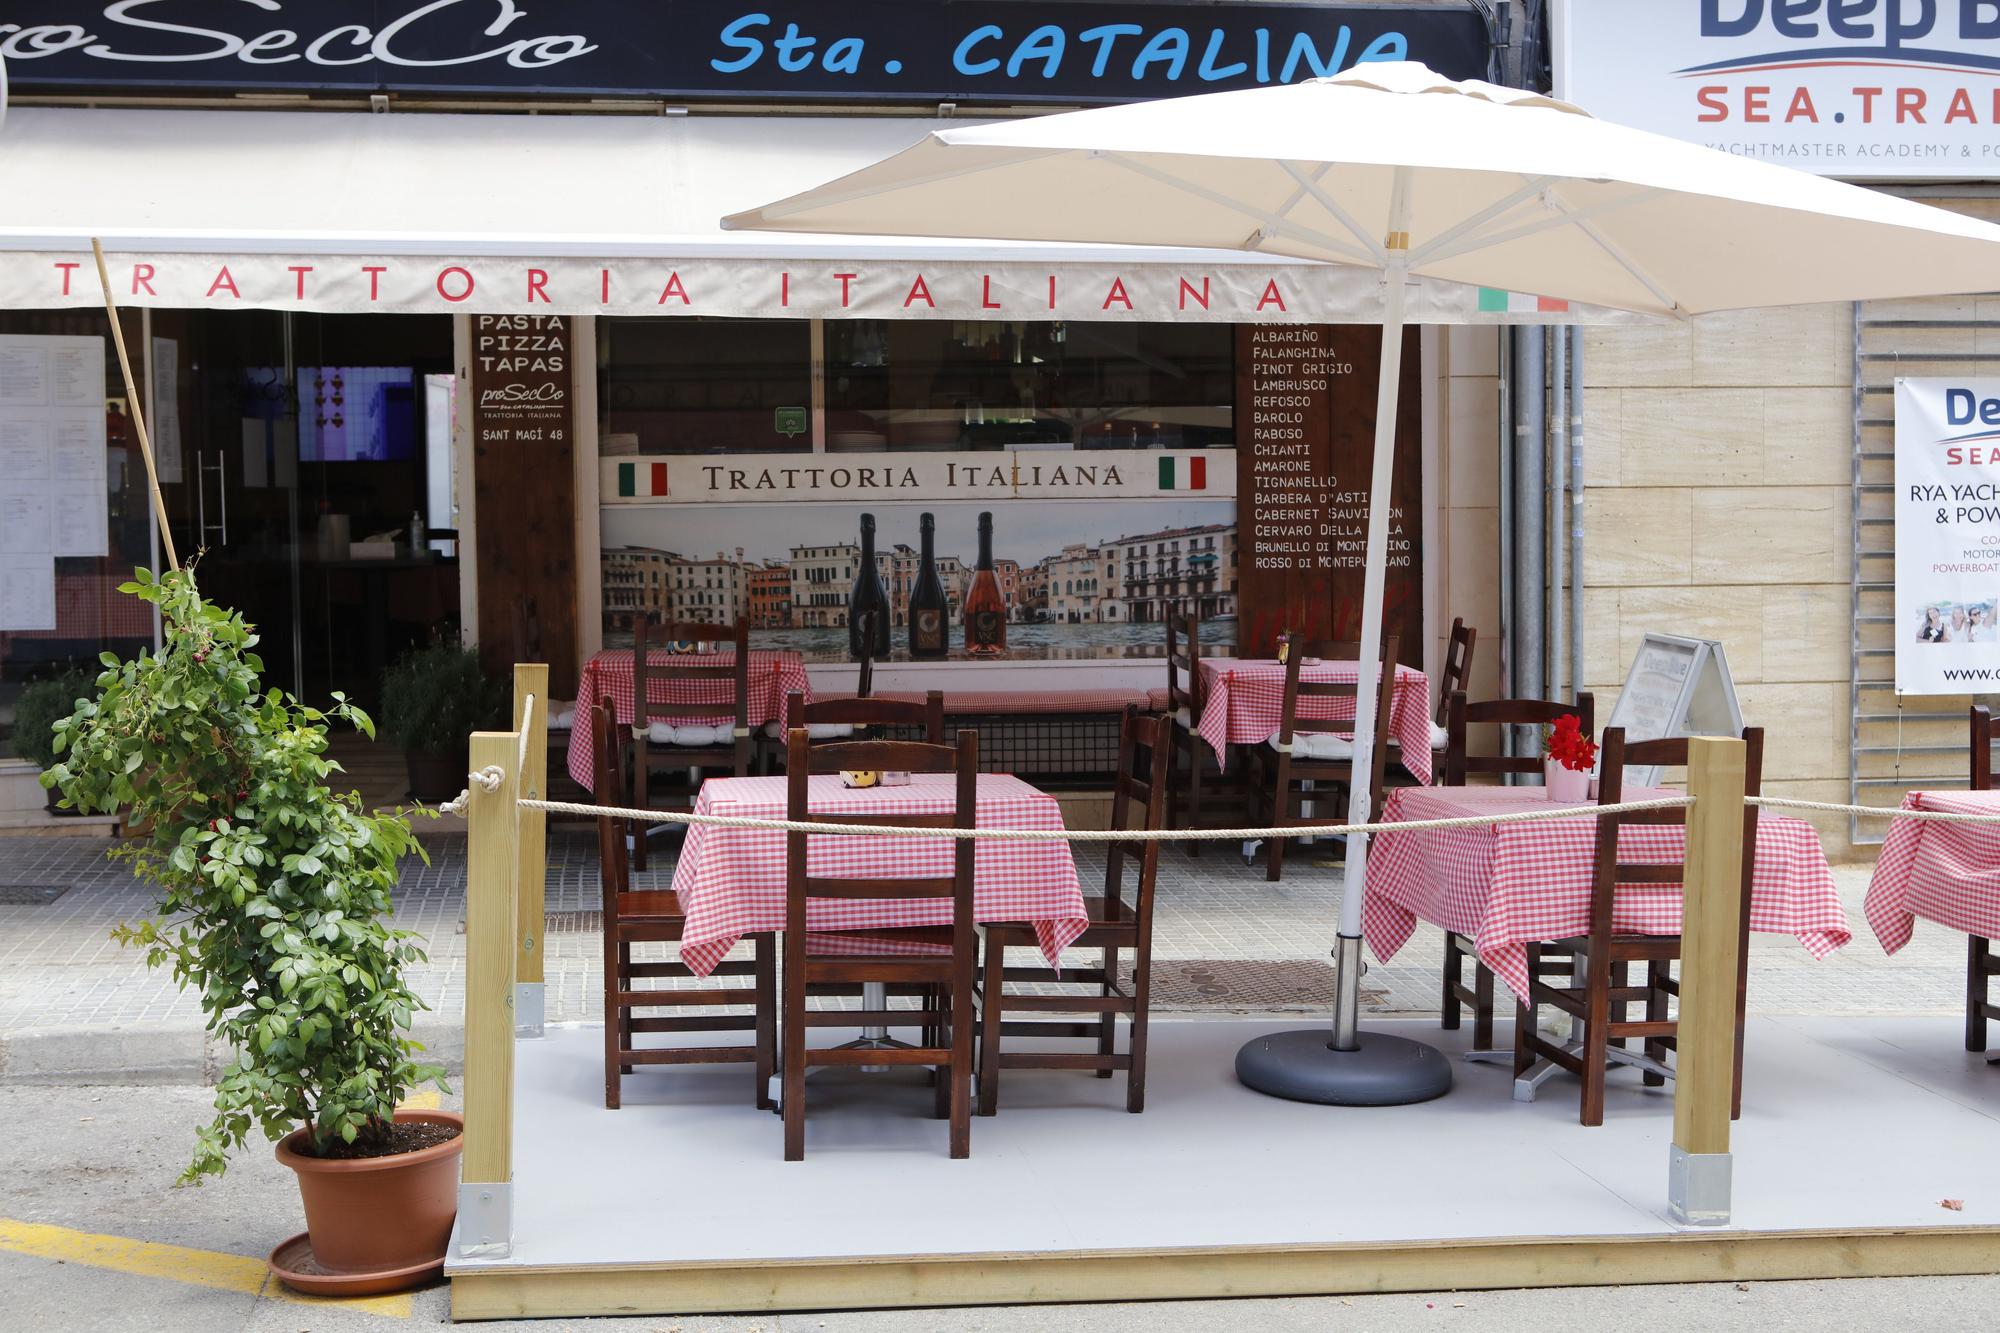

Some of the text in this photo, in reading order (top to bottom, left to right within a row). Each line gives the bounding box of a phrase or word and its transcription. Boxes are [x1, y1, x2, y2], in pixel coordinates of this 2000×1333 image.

[0, 0, 598, 68] oSecCo
[709, 12, 1408, 83] Sta. CATALINA
[1857, 143, 1951, 157] ACADEMY
[1961, 144, 1971, 158] &
[54, 262, 1286, 312] TRATTORIA ITALIANA
[480, 315, 564, 330] PASTA
[1253, 330, 1319, 343] ALBARIÑO
[480, 336, 564, 351] PIZZA
[1253, 347, 1336, 359] FALANGHINA
[479, 357, 564, 372] TAPAS
[1253, 363, 1353, 375] PINOT GRIGIO
[1253, 380, 1327, 391] LAMBRUSCO
[1254, 396, 1311, 407] REFOSCO
[1254, 412, 1303, 423] BAROLO
[483, 429, 510, 440] SANT
[550, 429, 563, 440] 48
[1254, 428, 1303, 439] RABOSO
[1254, 444, 1311, 456] CHIANTI
[1254, 461, 1311, 472] AMARONE
[703, 462, 1123, 490] TRATTORIA ITALIANA
[1254, 476, 1338, 488] TIGNANELLO
[1255, 493, 1312, 504] BARBERA
[1911, 485, 1948, 502] RYA
[1255, 507, 1403, 520] CABERNET SAUVION
[1936, 507, 1949, 524] &
[1255, 524, 1313, 536] CERVARO
[1320, 523, 1362, 536] DELLA
[1255, 540, 1411, 553] BRUNELLO DI MONTINO
[1255, 555, 1411, 569] ROSSO DI MONTEPUANO
[1933, 563, 1998, 573] POWERBOAT
